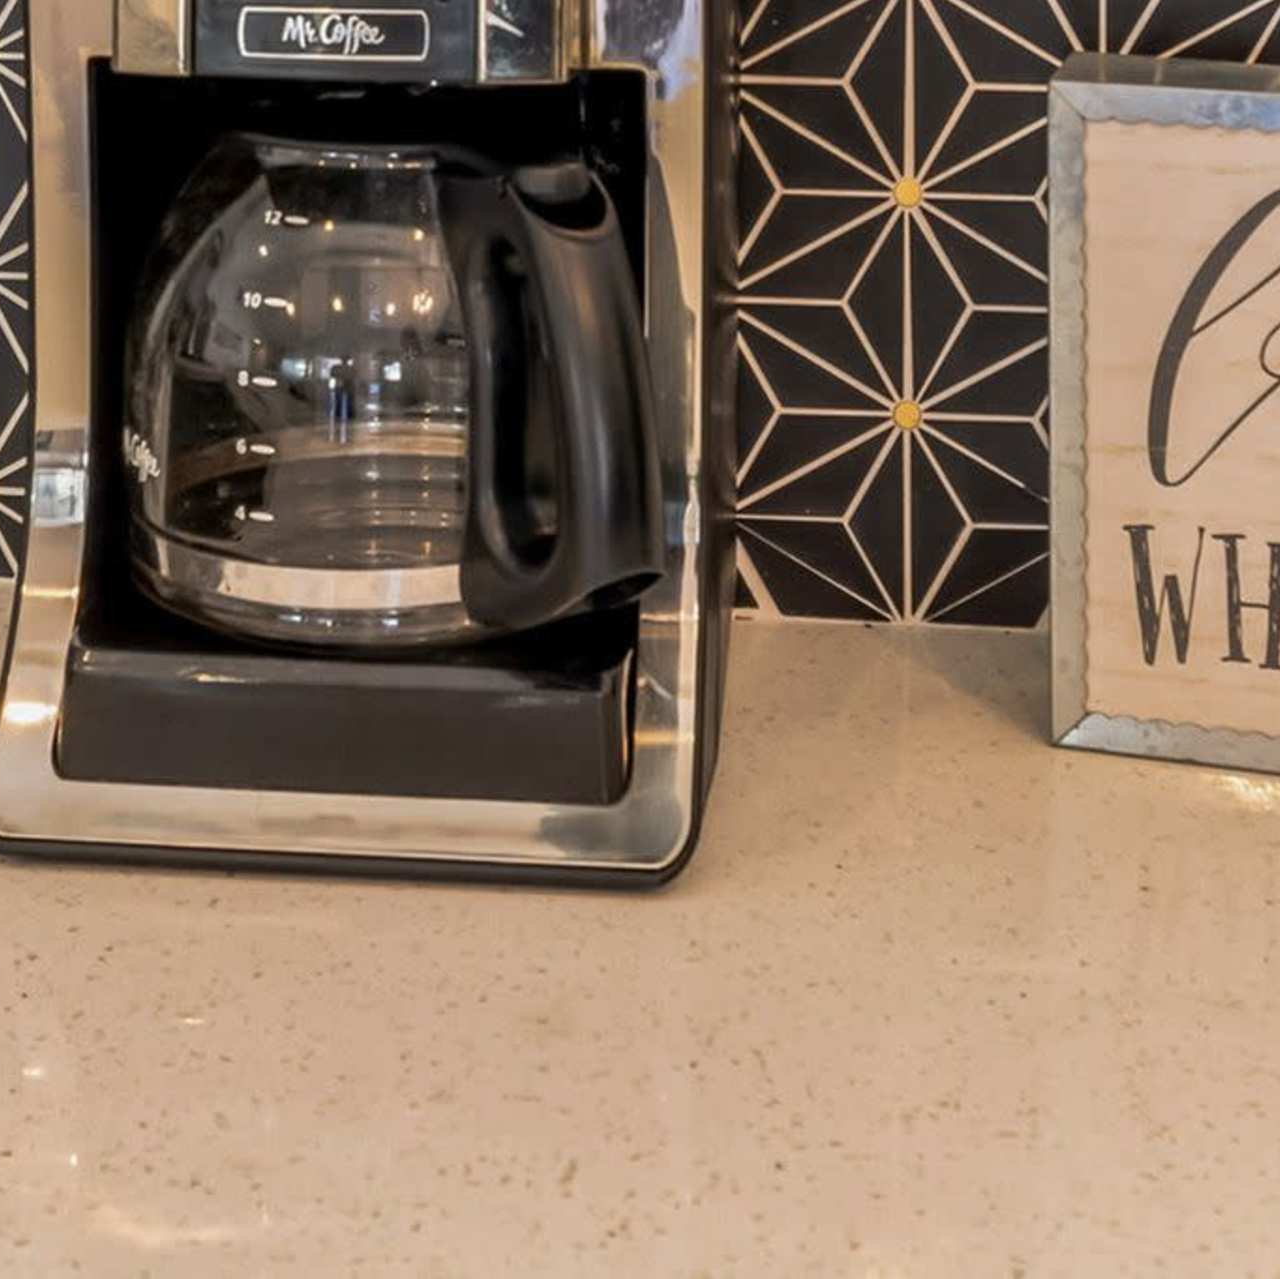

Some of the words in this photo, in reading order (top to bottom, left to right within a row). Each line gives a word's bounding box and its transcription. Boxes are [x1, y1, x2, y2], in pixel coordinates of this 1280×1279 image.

[320, 14, 385, 55] Coffee
[265, 210, 282, 225] 12
[243, 292, 262, 308] 10
[237, 370, 249, 387] 8
[236, 438, 247, 454] 6
[234, 505, 246, 521] 4
